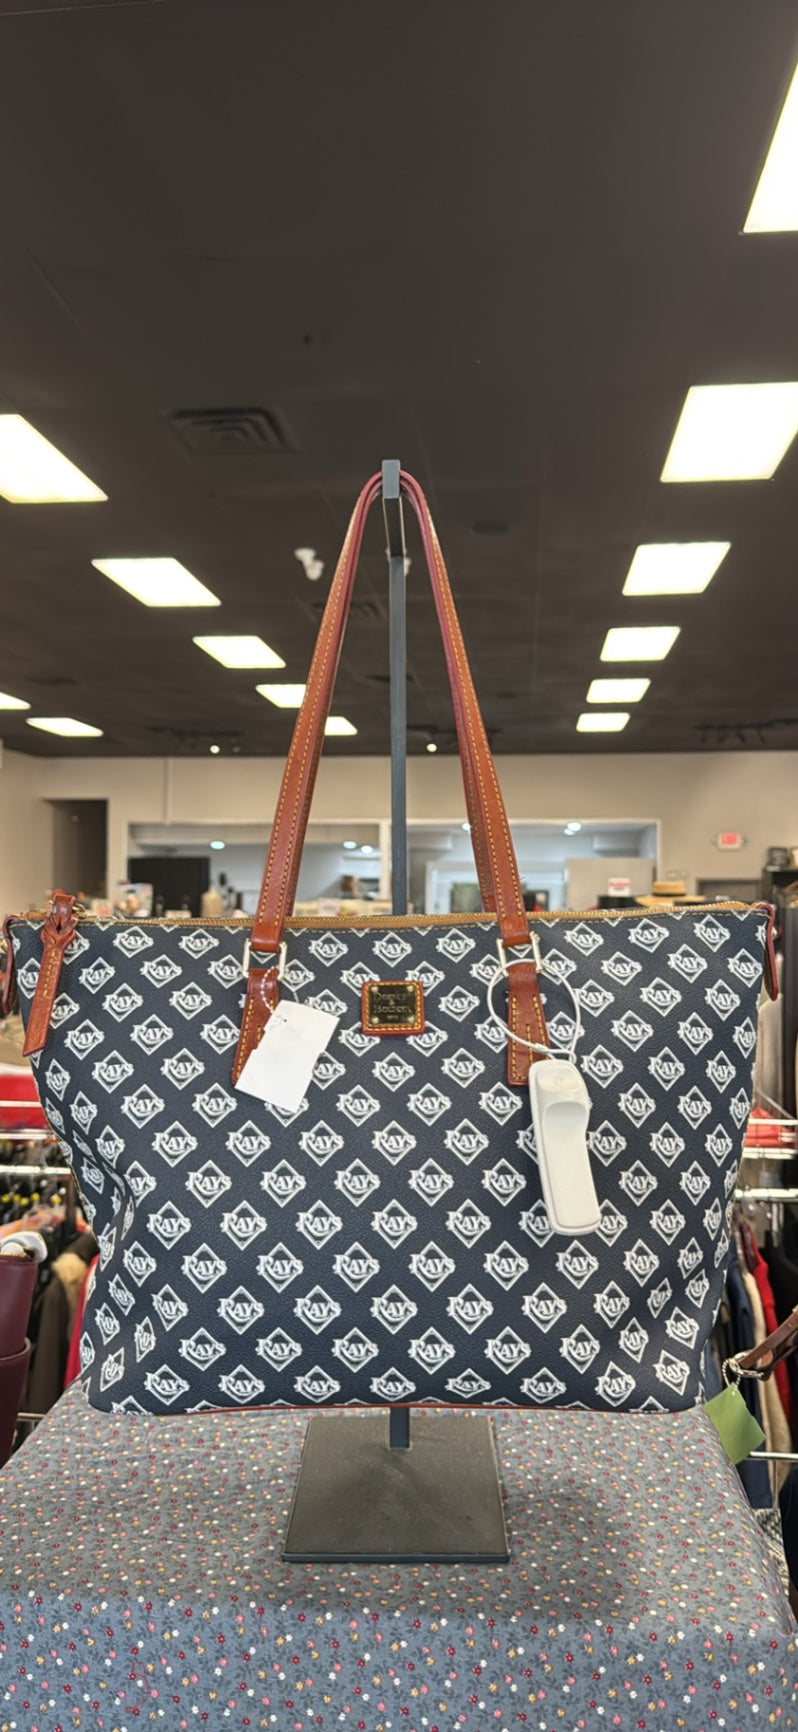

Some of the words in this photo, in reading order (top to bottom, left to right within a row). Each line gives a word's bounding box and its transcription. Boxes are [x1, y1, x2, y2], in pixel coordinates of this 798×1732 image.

[113, 933, 154, 951] RAYS
[565, 930, 604, 948] RAYS
[628, 926, 669, 945] RAYS
[694, 924, 730, 942] RAYS
[178, 936, 219, 955] RAYS
[308, 939, 349, 958] RAYS
[372, 939, 412, 959] RAYS
[436, 936, 476, 955] RAYS
[140, 963, 183, 981] RAYS
[602, 959, 642, 977] RAYS
[668, 954, 708, 973] RAYS
[727, 959, 762, 977] RAYS
[79, 967, 115, 986] RAYS
[103, 993, 143, 1012] RAYS
[170, 991, 212, 1010] RAYS
[438, 994, 479, 1013] RAYS
[640, 987, 682, 1005] RAYS
[705, 991, 740, 1010] RAYS
[65, 1029, 105, 1049] RAYS
[131, 1024, 174, 1043] RAYS
[612, 1020, 654, 1040] RAYS
[678, 1022, 713, 1043] RAYS
[92, 1060, 134, 1080] RAYS
[160, 1059, 205, 1079] RAYS
[312, 1062, 346, 1080] AYS
[372, 1061, 415, 1080] RAYS
[442, 1058, 485, 1078] RAYS
[581, 1055, 624, 1075] RAYS
[648, 1056, 685, 1078] RAYS
[121, 1094, 164, 1115] RAYS
[192, 1092, 237, 1114] RAYS
[336, 1094, 380, 1115] RAYS
[407, 1093, 452, 1114] RAYS
[479, 1092, 522, 1114] RAYS
[618, 1092, 656, 1114] RAYS
[678, 1095, 712, 1117] RAYS
[152, 1132, 197, 1155] RAYS
[226, 1131, 271, 1154] RAYS
[299, 1131, 344, 1154] RAYS
[371, 1131, 416, 1153] RAYS
[444, 1129, 489, 1153] RAYS
[588, 1132, 626, 1153] RAYS
[650, 1132, 685, 1154] RAYS
[185, 1171, 231, 1195] RAYS
[260, 1170, 306, 1195] RAYS
[334, 1169, 380, 1194] RAYS
[408, 1169, 454, 1193] RAYS
[482, 1169, 526, 1193] RAYS
[619, 1171, 657, 1193] RAYS
[680, 1171, 710, 1193] RAYS
[147, 1212, 191, 1236] RAYS
[220, 1212, 267, 1237] RAYS
[296, 1211, 342, 1236] RAYS
[371, 1210, 417, 1236] RAYS
[446, 1210, 490, 1235] RAYS
[600, 1211, 627, 1232] AYS
[650, 1210, 685, 1233] RAYS
[182, 1254, 227, 1280] RAYS
[257, 1254, 303, 1279] RAYS
[333, 1253, 379, 1278] RAYS
[409, 1253, 455, 1278] RAYS
[484, 1252, 528, 1277] RAYS
[556, 1251, 598, 1276] RAYS
[624, 1250, 659, 1274] RAYS
[217, 1297, 264, 1321] RAYS
[294, 1297, 341, 1321] RAYS
[371, 1296, 417, 1321] RAYS
[447, 1295, 493, 1320] RAYS
[522, 1294, 566, 1319] RAYS
[594, 1292, 629, 1315] RAYS
[179, 1337, 225, 1359] RAYS
[256, 1337, 302, 1360] RAYS
[332, 1338, 378, 1360] RAYS
[408, 1338, 455, 1361] RAYS
[485, 1337, 531, 1361] RAYS
[560, 1336, 599, 1360] RAYS
[145, 1374, 189, 1394] RAYS
[219, 1373, 264, 1393] RAYS
[294, 1374, 340, 1392] RAYS
[370, 1375, 415, 1392] RAYS
[446, 1375, 490, 1390] RAYS
[521, 1376, 566, 1393] RAYS
[595, 1375, 636, 1397] RAYS
